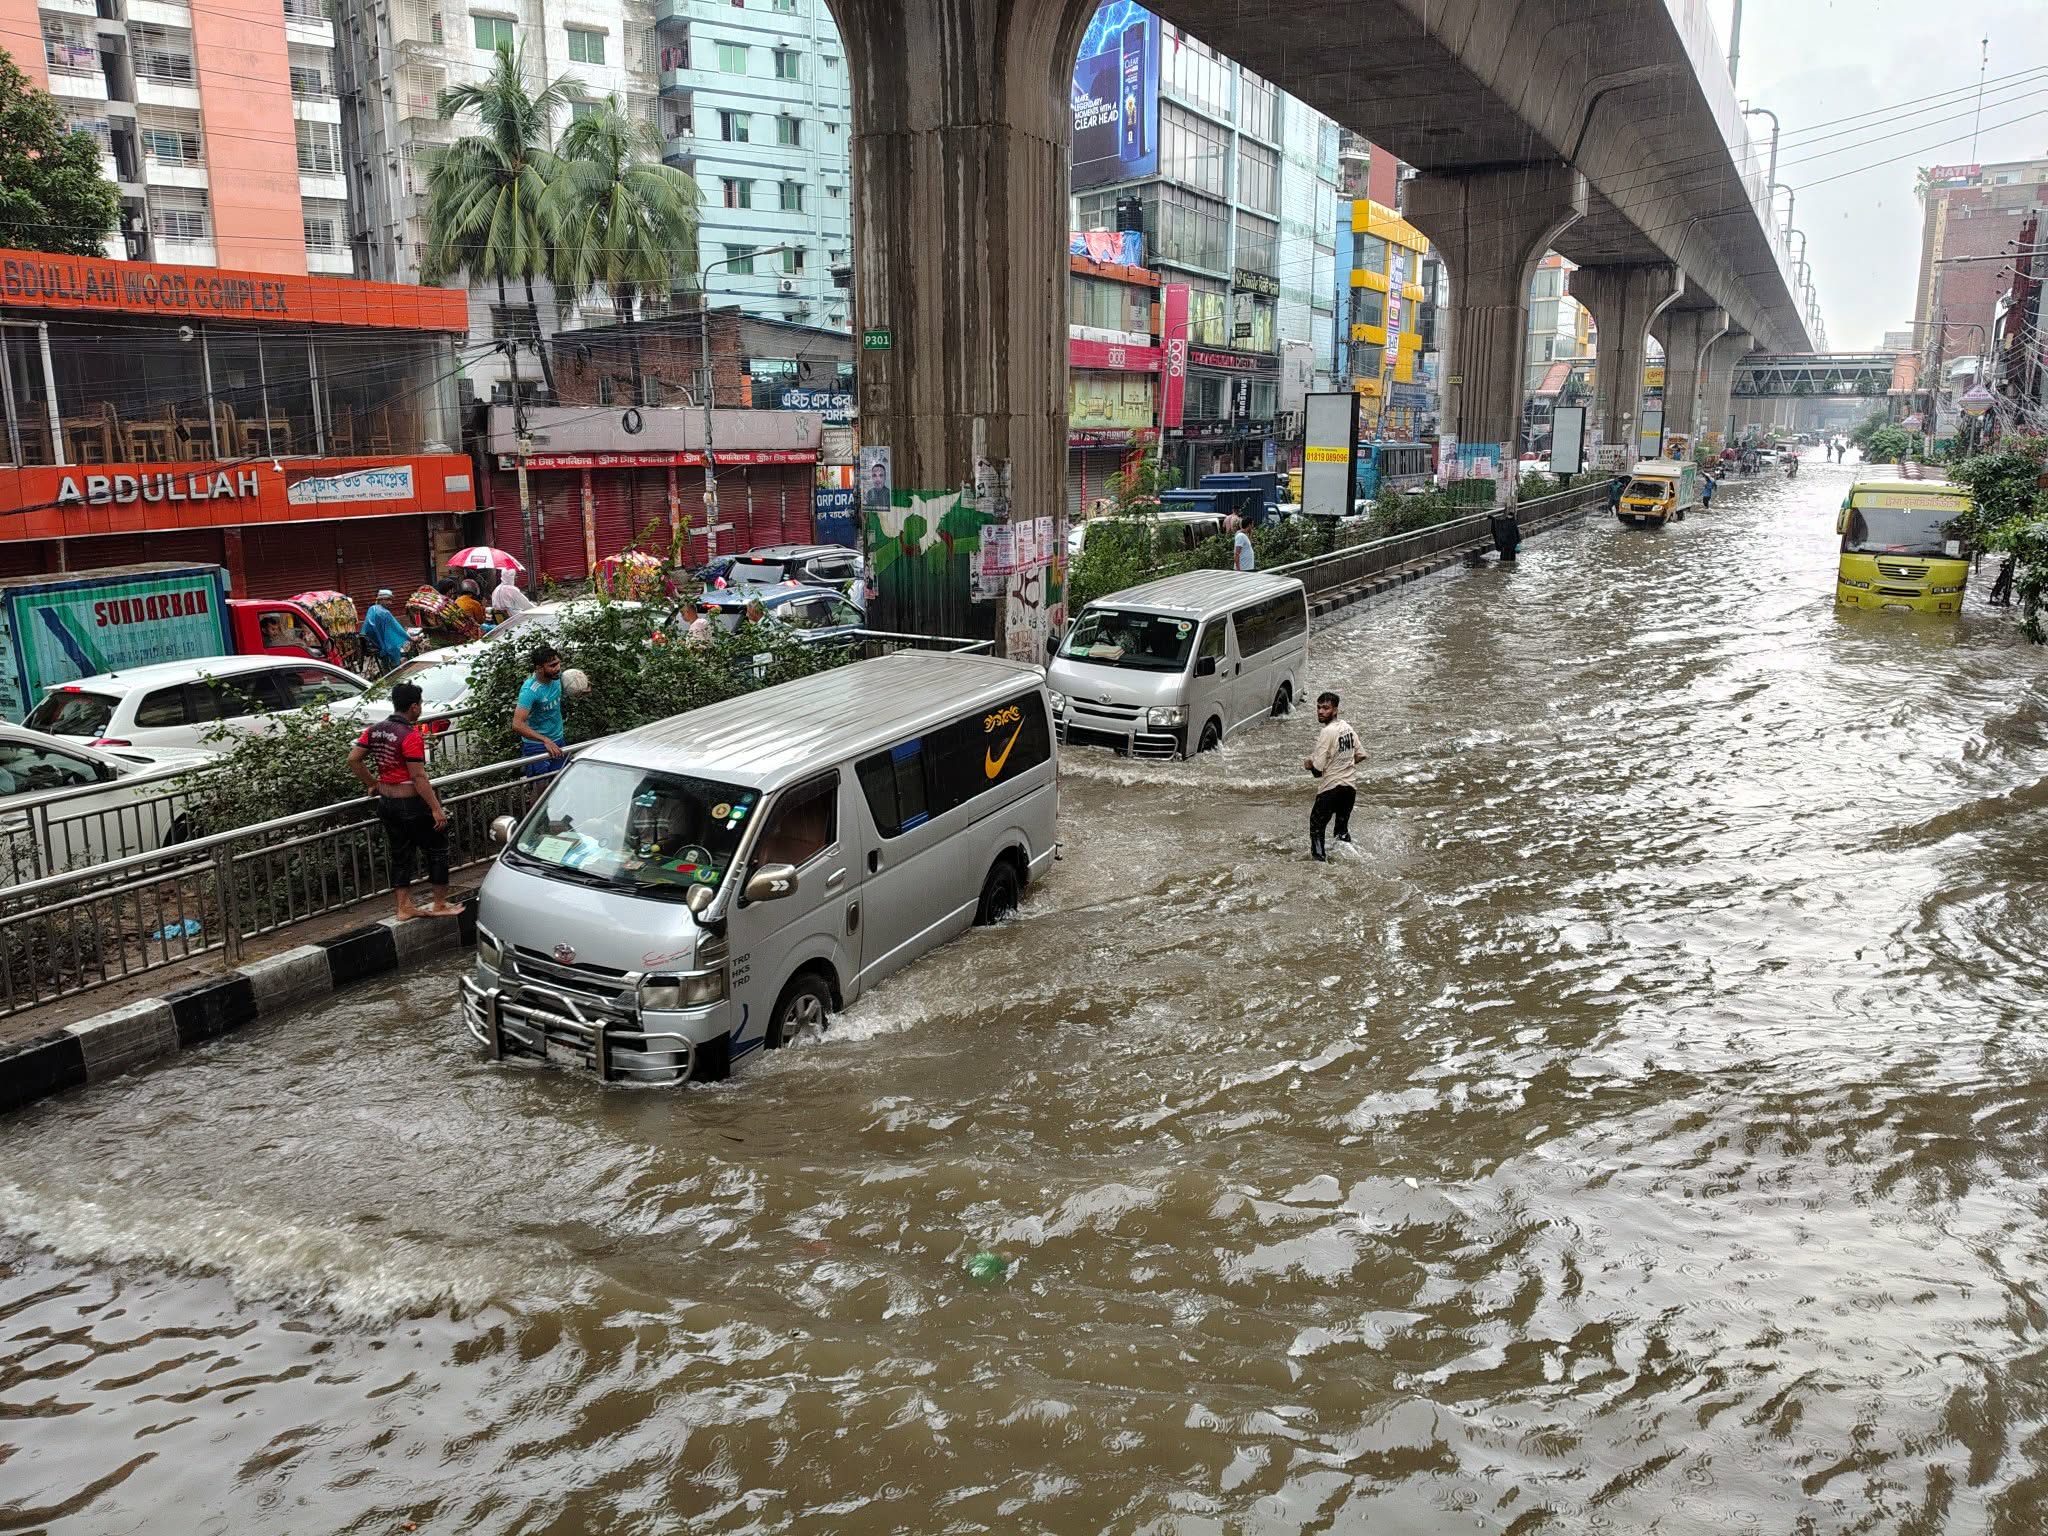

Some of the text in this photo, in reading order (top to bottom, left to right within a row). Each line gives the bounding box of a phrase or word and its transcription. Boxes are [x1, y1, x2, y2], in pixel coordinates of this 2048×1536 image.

[1075, 93, 1089, 103] MAKE
[1075, 97, 1103, 111] LEGENDARY
[1075, 101, 1117, 120] MOMENTS WITH A
[1075, 110, 1119, 130] CLEAR HEAD
[1935, 166, 1976, 178] HATIL
[0, 260, 289, 313] BDULLAH WOOD COMPLEX
[865, 335, 889, 345] P301
[1239, 378, 1248, 417] SAMSUNG
[1306, 452, 1348, 462] 01819 089096
[57, 470, 259, 505] ABDULLAH
[816, 493, 855, 507] ORPORA
[94, 589, 209, 627] SUNDARBAN
[732, 953, 751, 967] TRD
[732, 964, 751, 978] HKS
[732, 975, 751, 988] TRD
